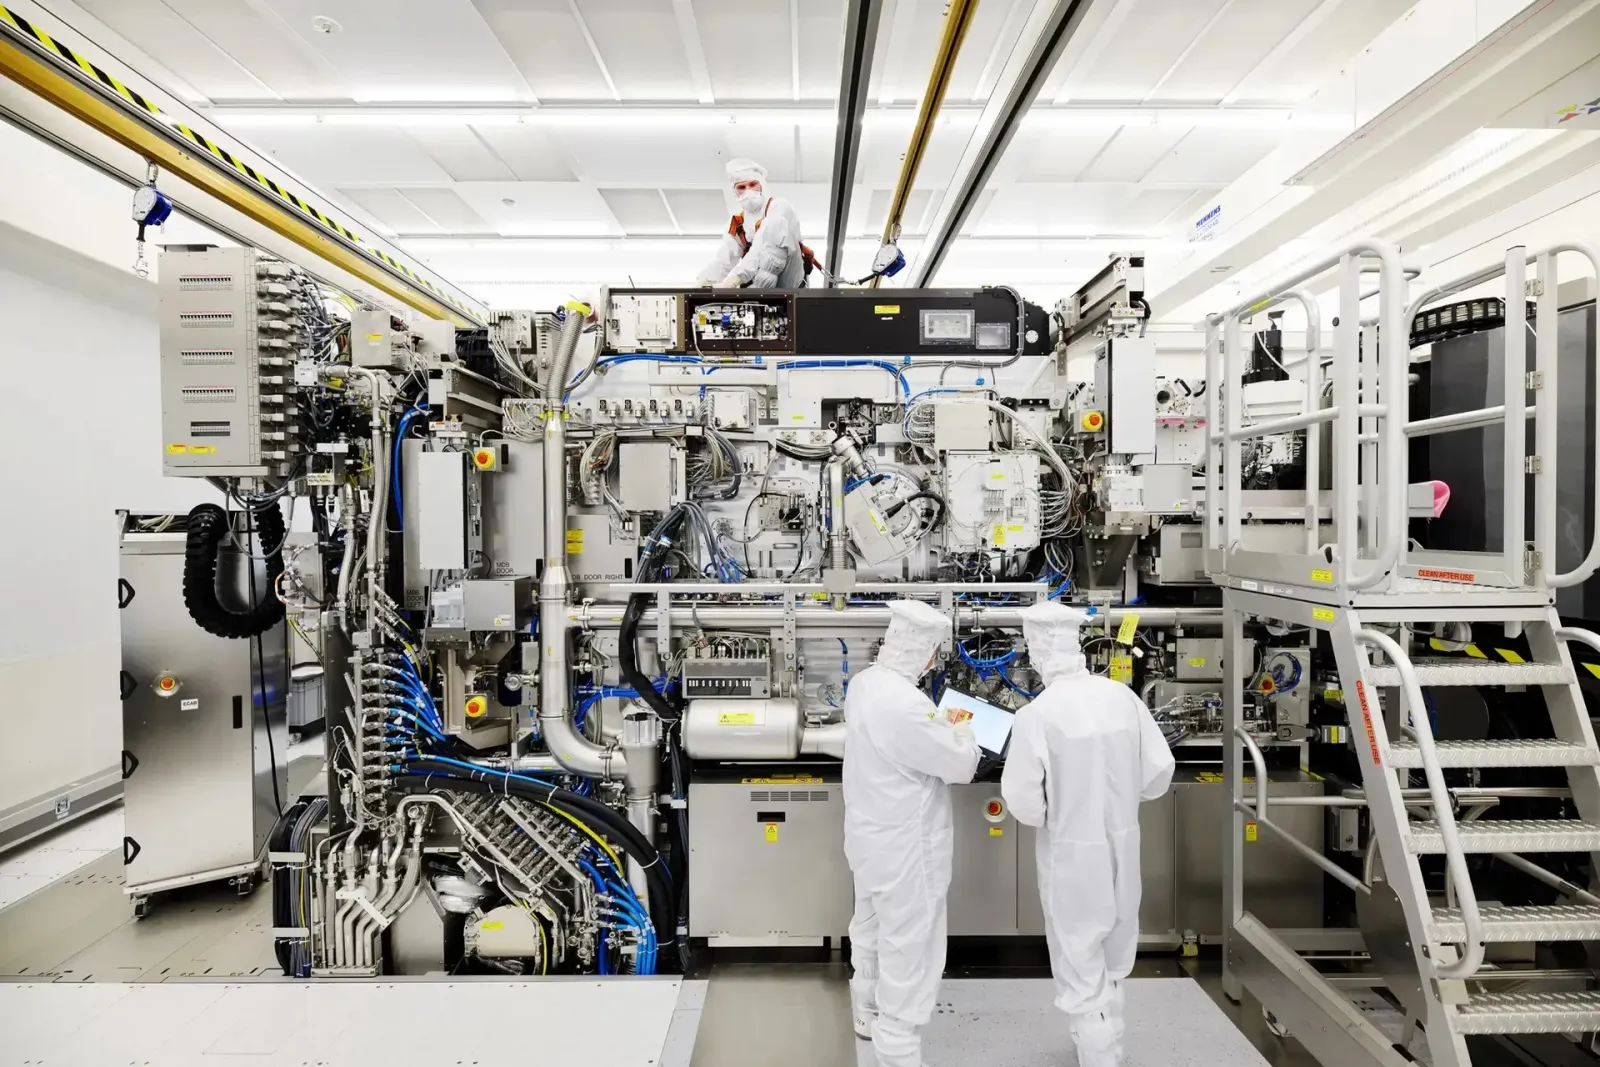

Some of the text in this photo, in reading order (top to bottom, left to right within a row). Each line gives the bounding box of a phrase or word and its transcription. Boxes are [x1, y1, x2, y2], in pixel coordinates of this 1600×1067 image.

[1418, 569, 1475, 581] CLEAN AFTER USE
[1356, 680, 1381, 765] CLEAN AFTER USE
